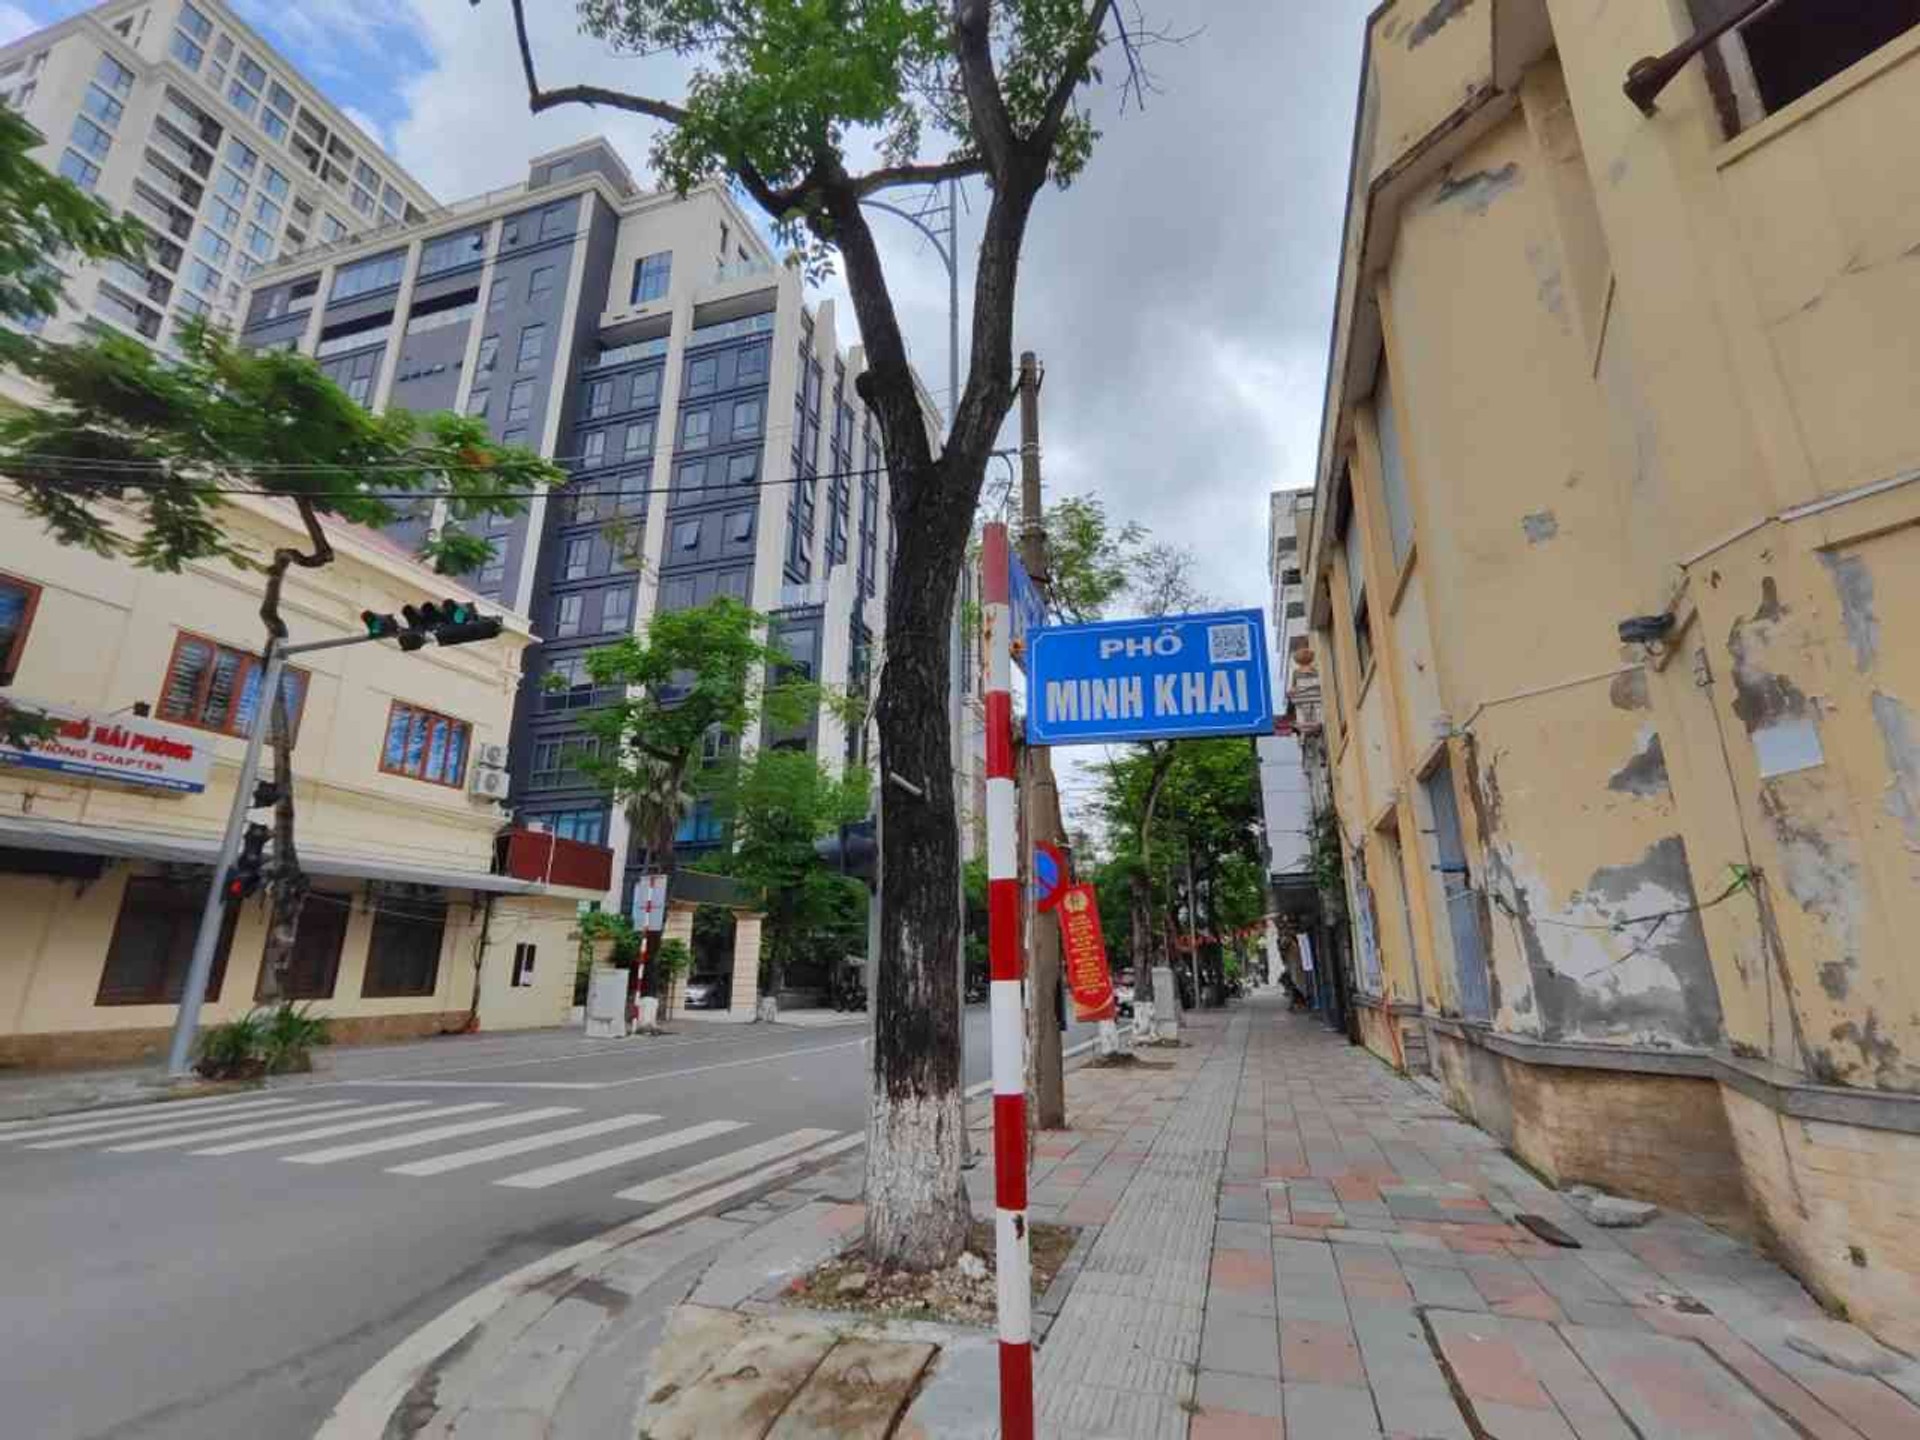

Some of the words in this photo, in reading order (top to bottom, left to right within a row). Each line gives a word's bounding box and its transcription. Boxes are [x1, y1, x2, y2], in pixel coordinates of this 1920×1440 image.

[1100, 624, 1185, 659] PHỐ
[1046, 675, 1143, 723] MINH
[1154, 669, 1249, 717] KHAI
[93, 751, 164, 772] CHAPTER
